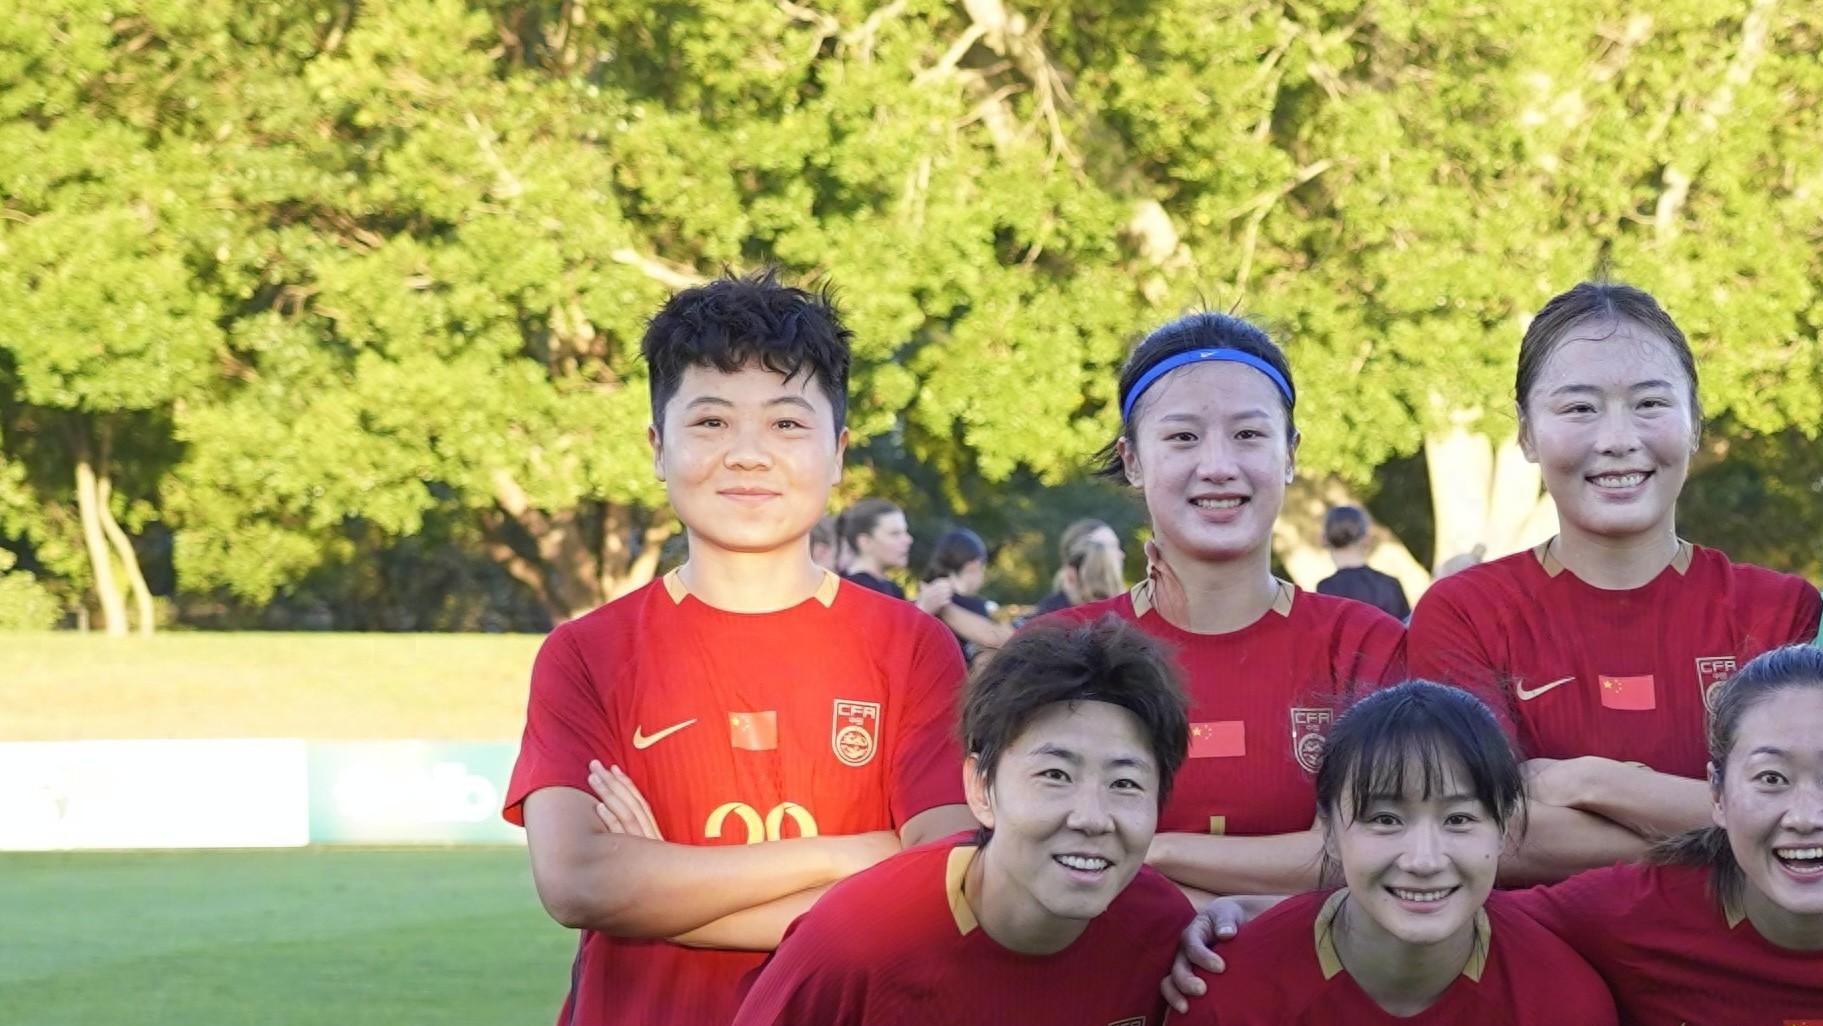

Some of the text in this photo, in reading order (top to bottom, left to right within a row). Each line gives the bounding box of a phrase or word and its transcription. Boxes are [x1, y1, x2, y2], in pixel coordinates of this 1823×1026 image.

[1701, 660, 1737, 673] CFA
[839, 704, 876, 720] CFA
[1295, 712, 1331, 724] CFA
